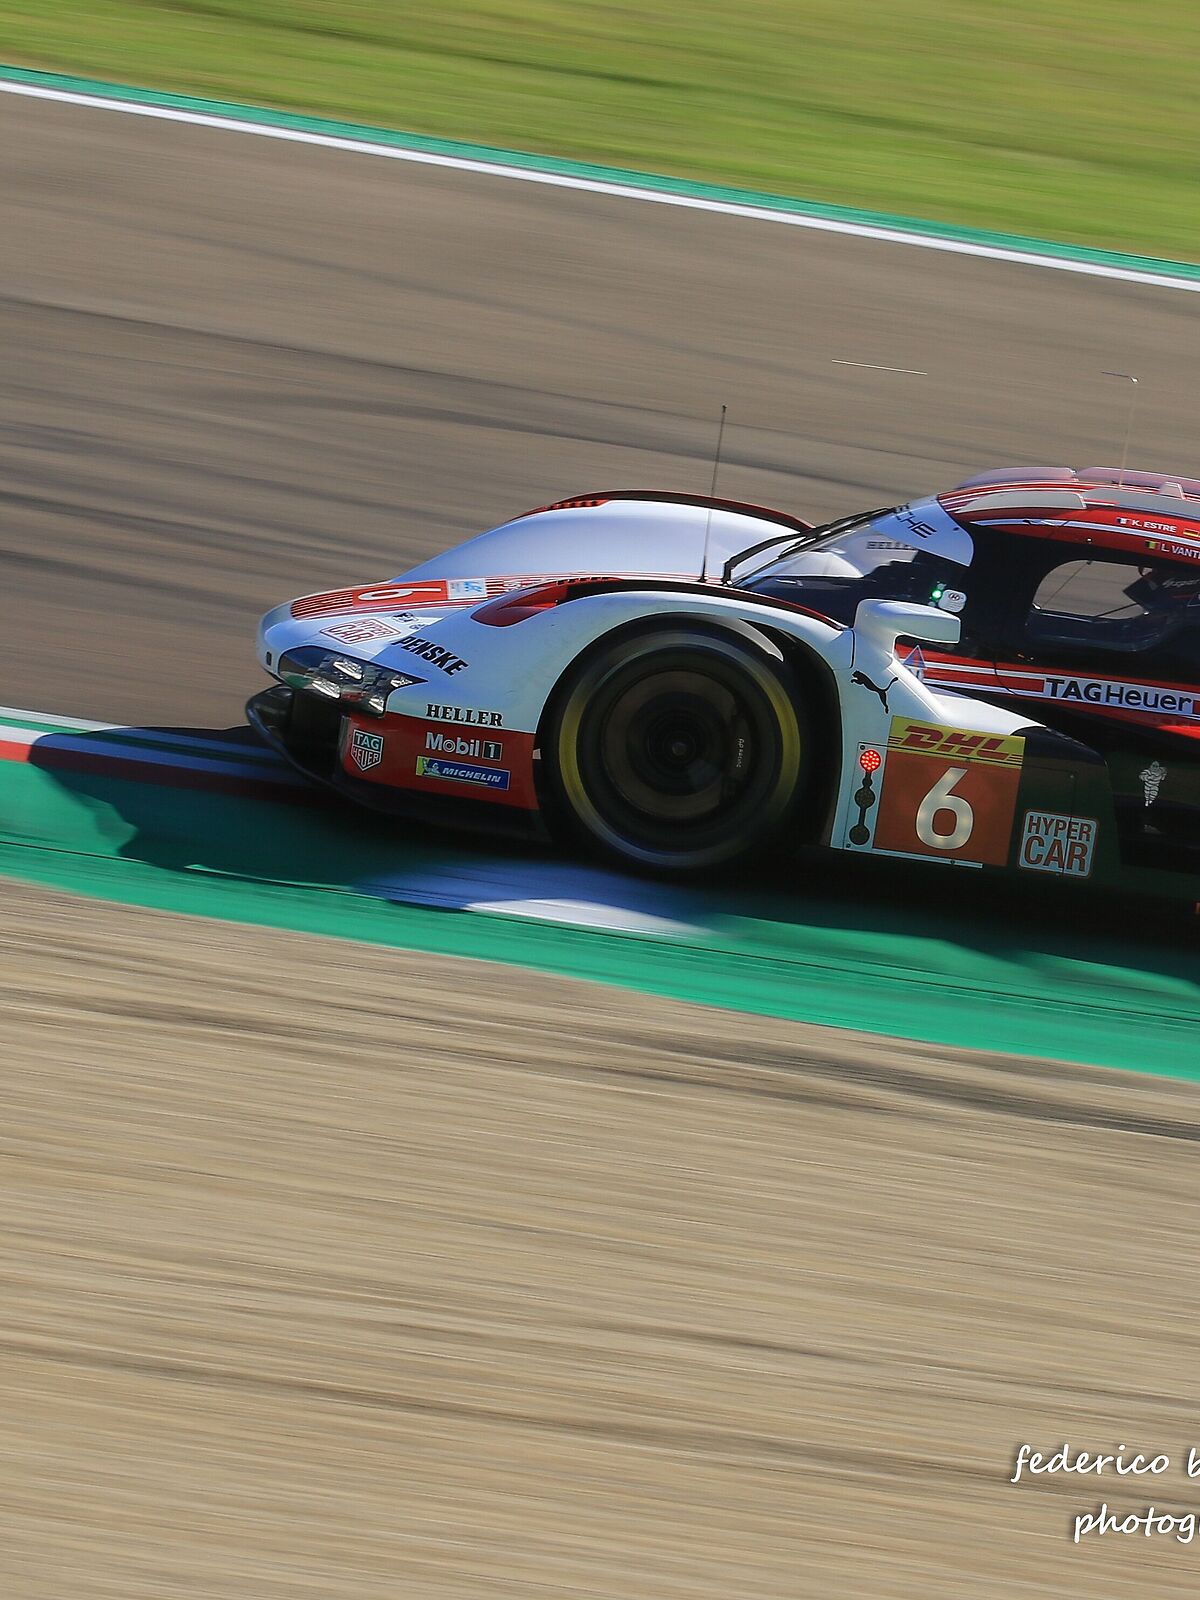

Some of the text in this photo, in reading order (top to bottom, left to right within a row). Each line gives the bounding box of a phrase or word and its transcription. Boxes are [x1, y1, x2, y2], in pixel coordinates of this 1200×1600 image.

[1131, 519, 1177, 533] K. ESTRE
[1161, 544, 1171, 553] L.
[391, 636, 469, 677] PENSKE
[425, 703, 504, 727] HELLER
[355, 732, 380, 750] TAG
[425, 732, 480, 757] Mobil
[899, 725, 1010, 761] DHL
[352, 747, 380, 767] HEUER
[442, 767, 502, 783] MICHELIN
[915, 767, 974, 851] 6
[1027, 815, 1092, 842] HYPER
[1024, 838, 1088, 873] CAR
